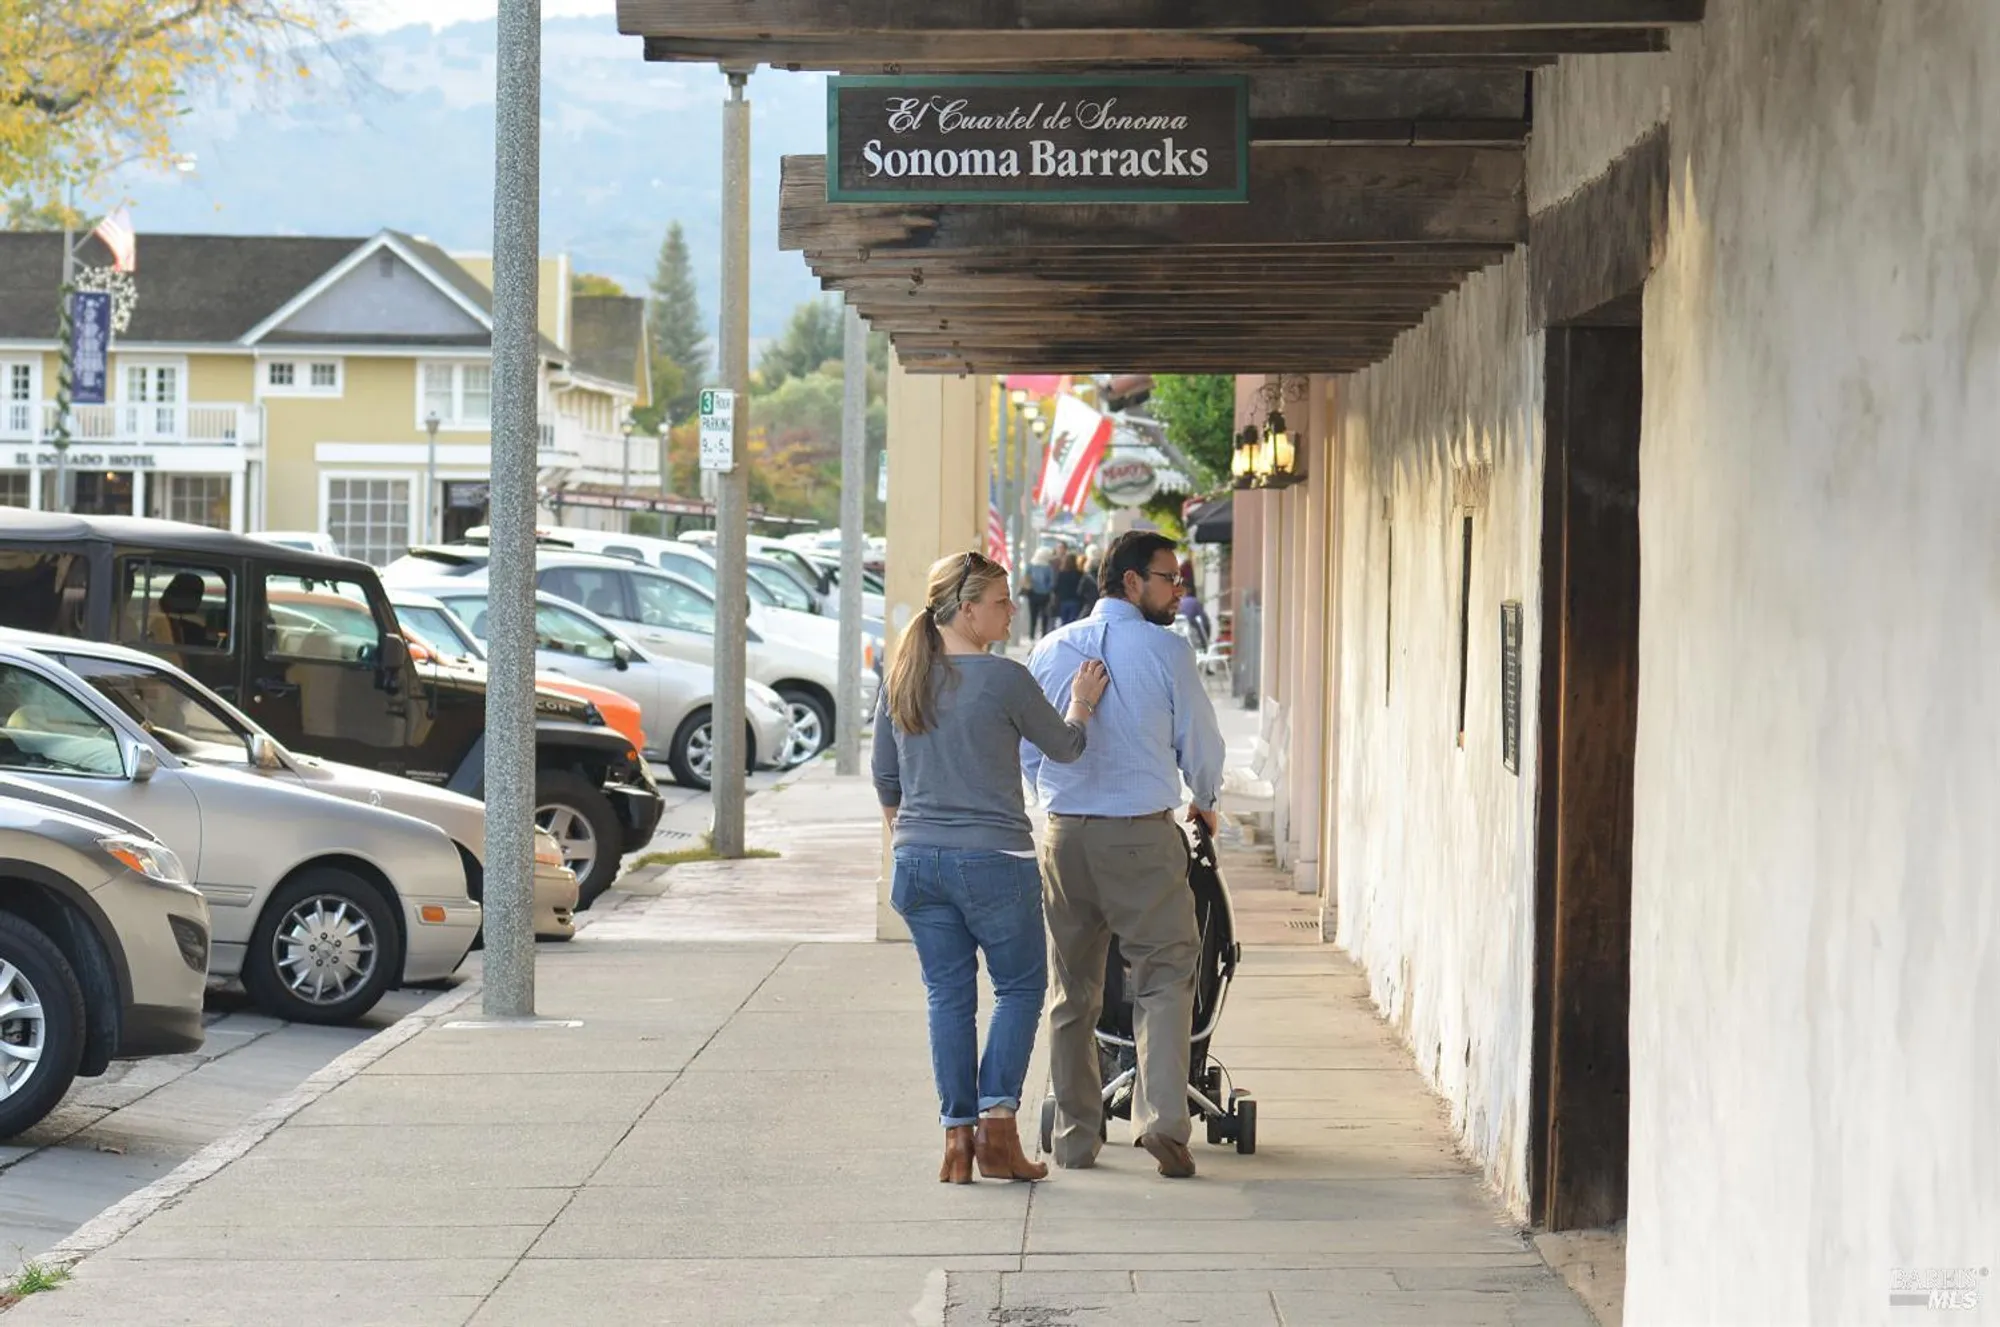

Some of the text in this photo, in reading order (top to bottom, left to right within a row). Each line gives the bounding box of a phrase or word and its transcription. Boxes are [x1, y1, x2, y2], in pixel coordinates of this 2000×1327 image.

[886, 95, 1189, 134] El Cuartel de Sonoma
[863, 138, 1210, 178] Sonoma Barracks
[703, 392, 712, 413] 3
[15, 452, 156, 467] EL DOADO HOTEL
